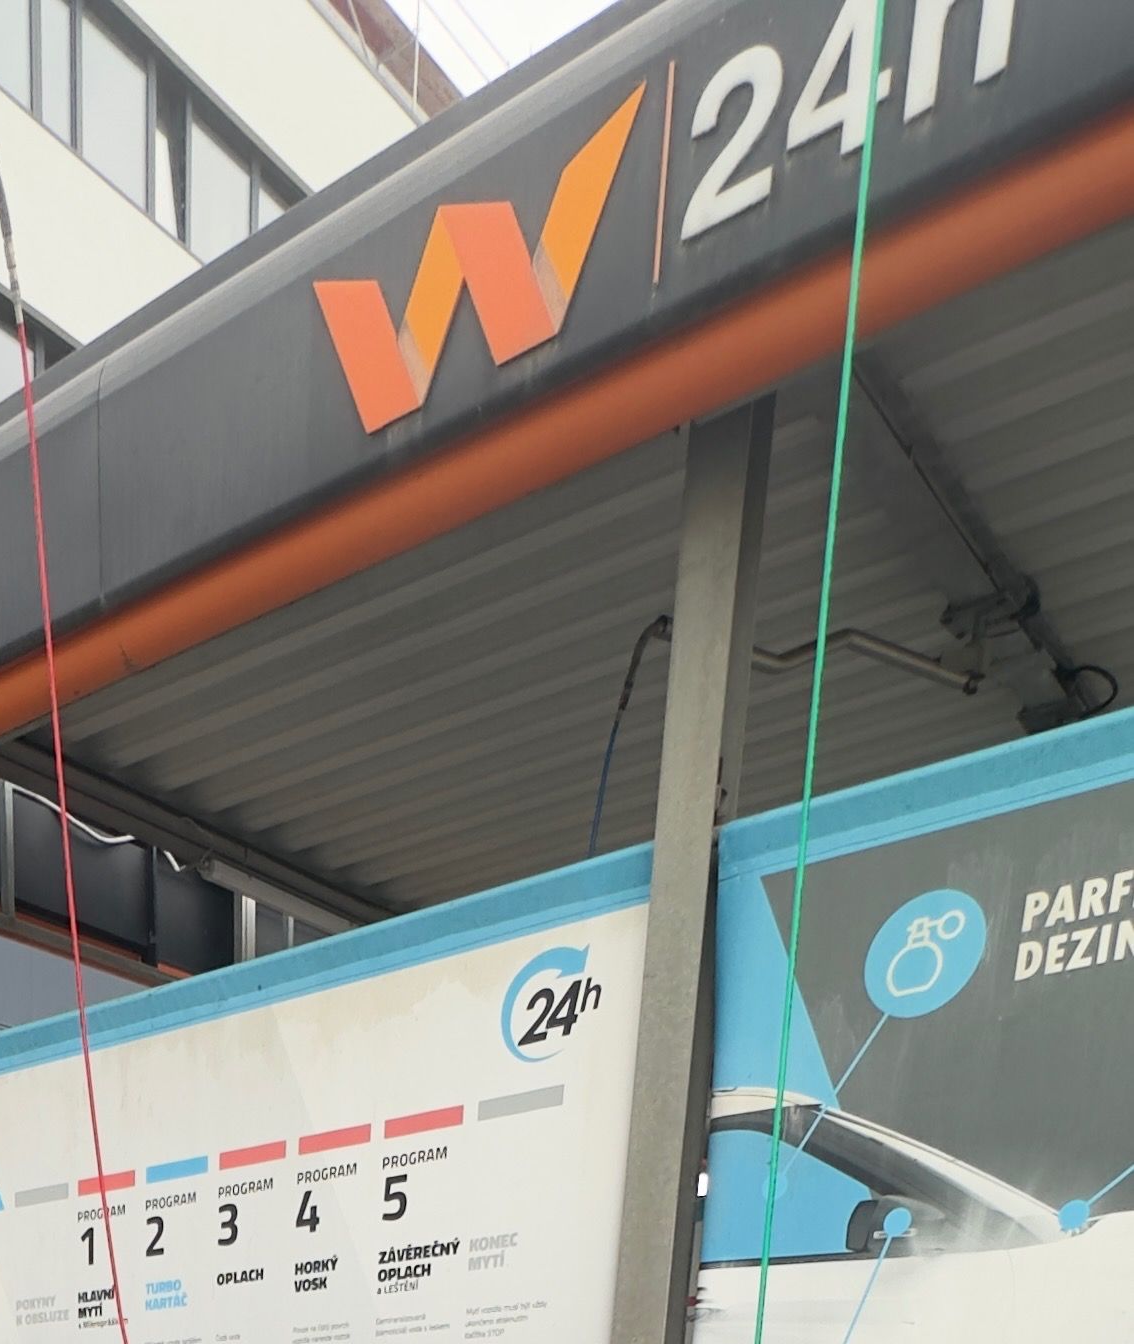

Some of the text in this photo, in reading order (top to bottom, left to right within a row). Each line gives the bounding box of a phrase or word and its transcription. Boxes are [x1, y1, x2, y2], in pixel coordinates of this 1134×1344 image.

[1021, 869, 1134, 933] PARF
[517, 976, 602, 1047] 24h
[382, 1145, 448, 1170] PROGRAM
[296, 1162, 358, 1185] PROGRAM
[218, 1177, 274, 1199] PROGRAM
[382, 1173, 408, 1222] 5
[145, 1191, 197, 1211] PROGRAM
[295, 1190, 320, 1233] 4
[217, 1203, 239, 1247] 3
[80, 1226, 95, 1266] 1
[145, 1215, 165, 1258] 2
[469, 1232, 519, 1253] KONEC
[378, 1236, 461, 1265] ZÁVĚREČNÝ
[468, 1250, 505, 1271] MYTÍ
[294, 1254, 339, 1276] HORKÝ
[377, 1263, 432, 1283] OPLACH
[145, 1279, 182, 1295] TURBO
[216, 1268, 265, 1286] OPLACH
[294, 1277, 328, 1293] VOSK
[15, 1294, 57, 1311] POKYNY
[77, 1302, 103, 1319] MYTÍ
[145, 1292, 188, 1311] KARTÁČ
